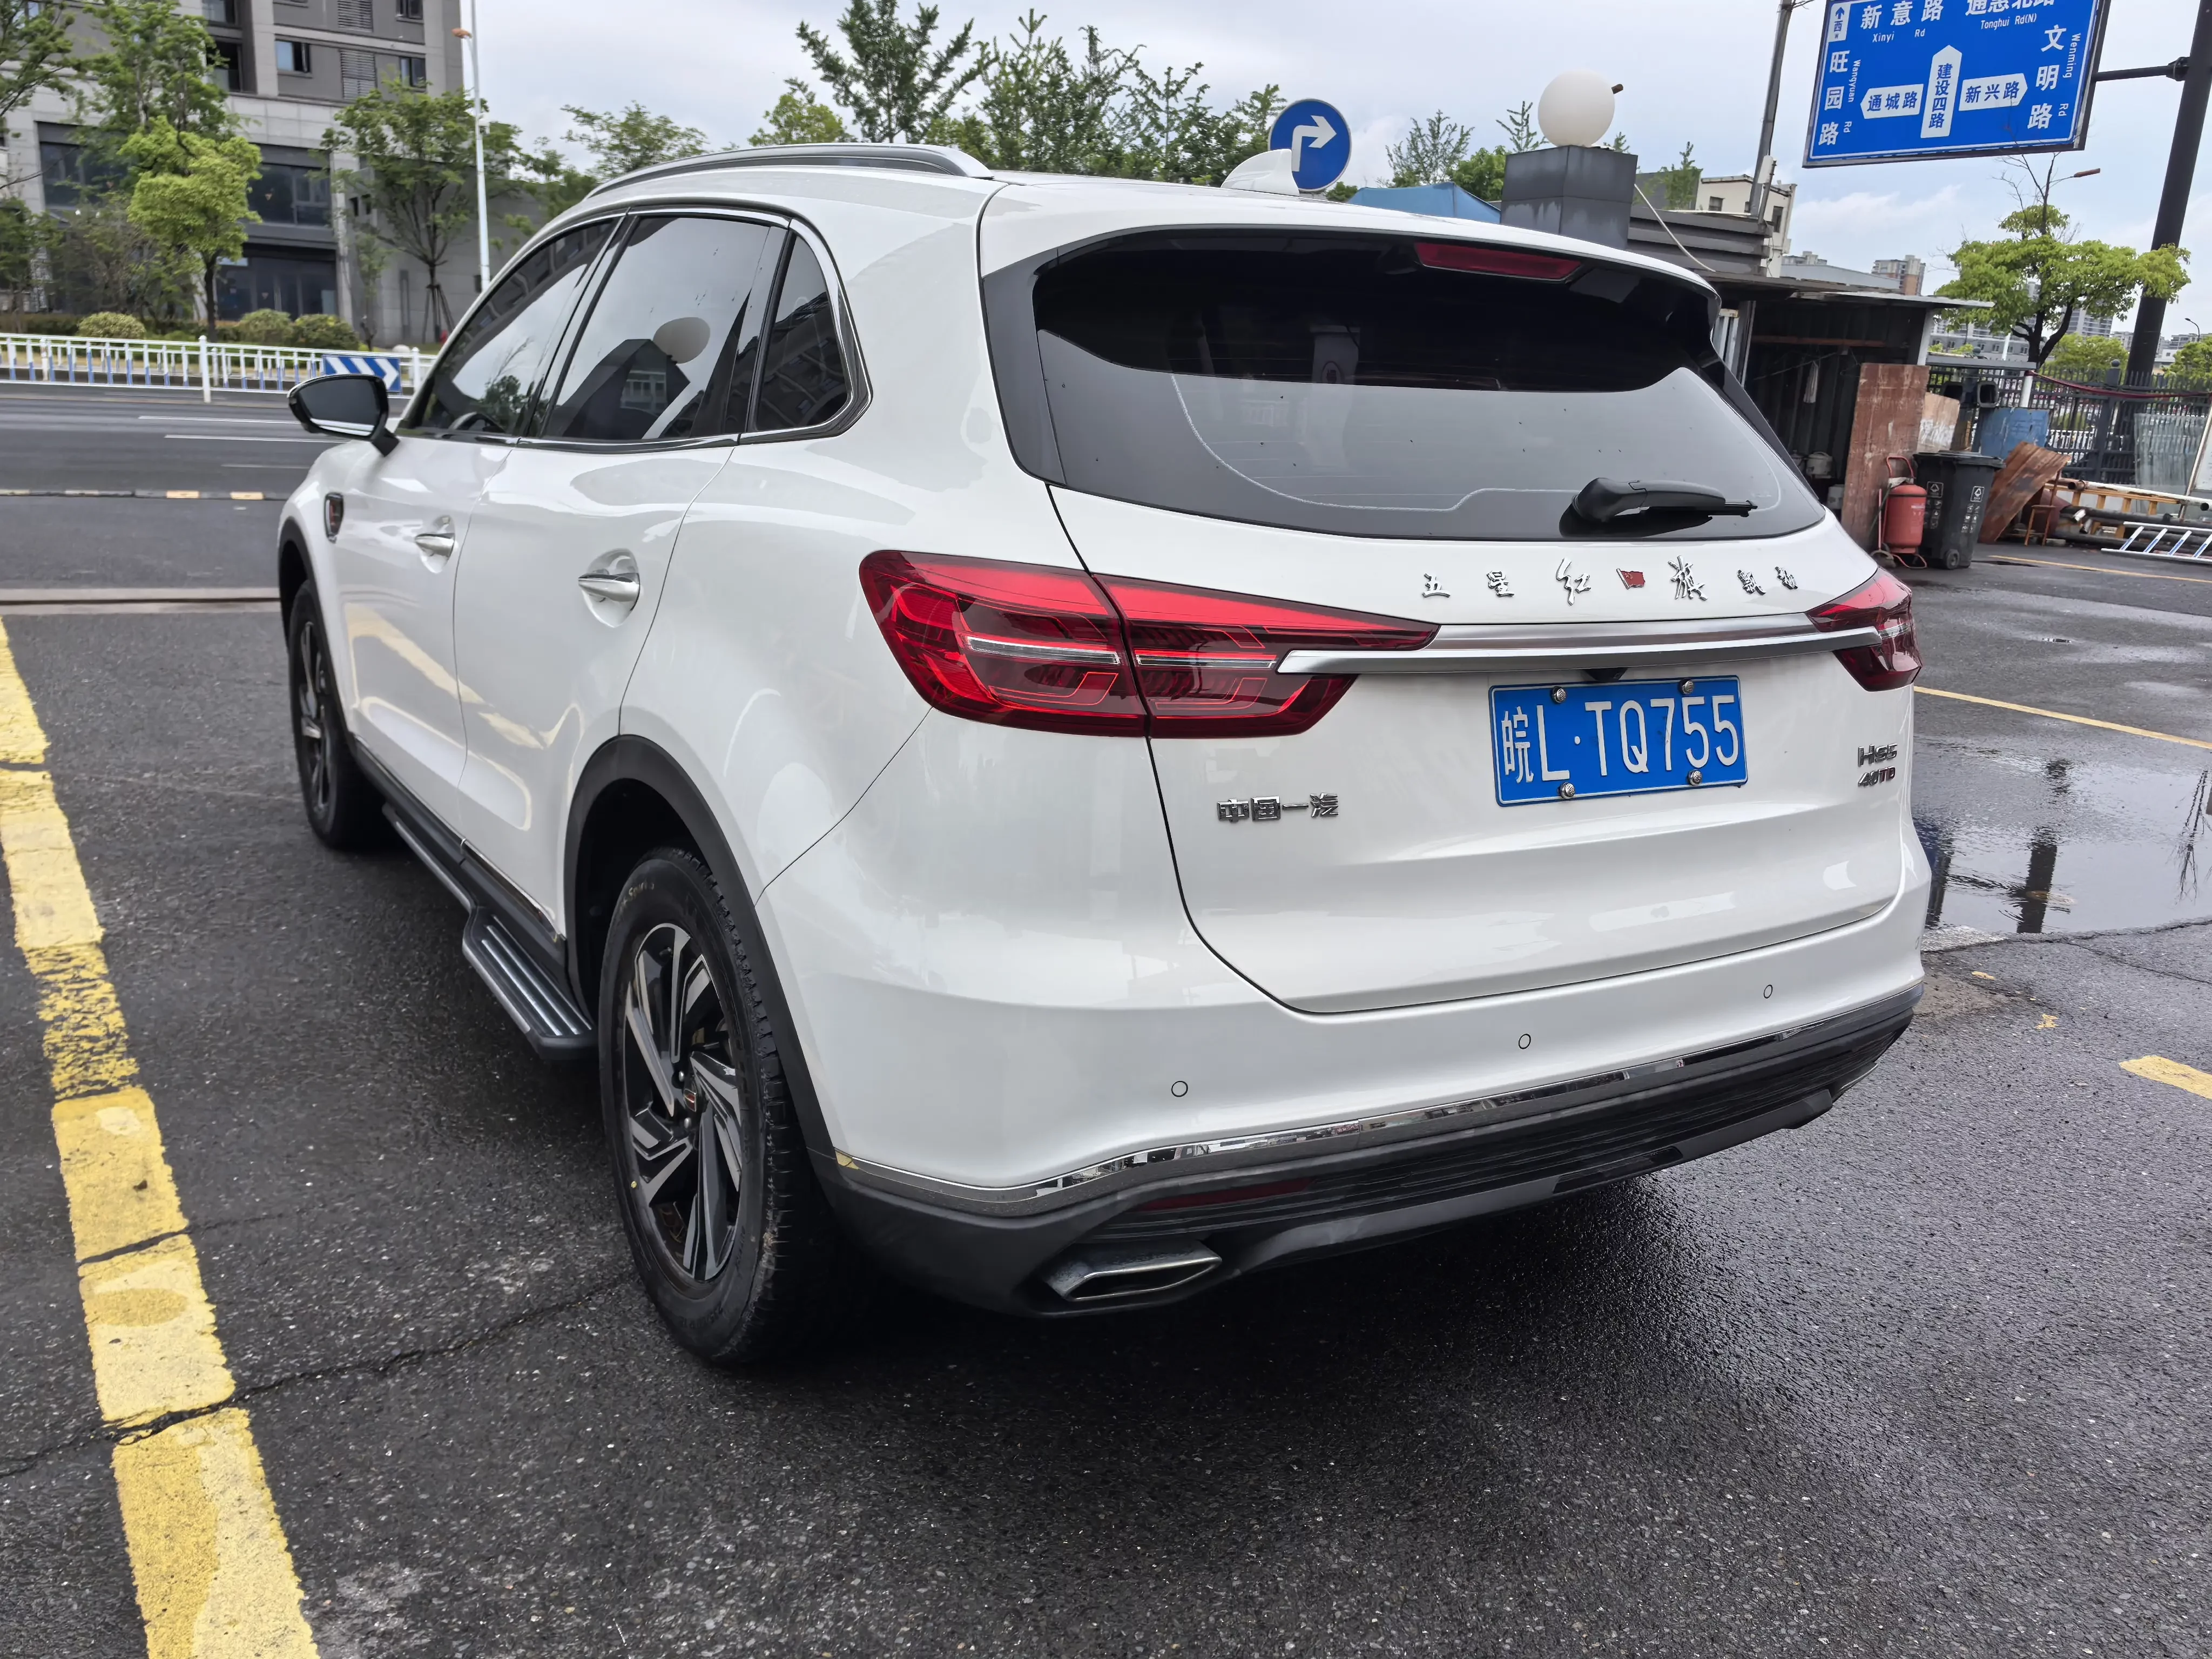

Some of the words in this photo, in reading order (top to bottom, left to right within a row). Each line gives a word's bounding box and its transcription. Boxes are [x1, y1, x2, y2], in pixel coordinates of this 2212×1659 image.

[1833, 20, 1844, 32] 西
[1860, 0, 1944, 29] 新意路
[1980, 16, 2010, 30] Tonghui
[2014, 12, 2037, 26] Rd(N)
[1872, 31, 1895, 43] Xinyi
[1914, 28, 1926, 38] Rd
[2062, 33, 2082, 79] Wenming
[1847, 59, 1862, 103] Wangyuan
[2027, 24, 2067, 130] 文明路
[1818, 50, 1851, 146] 旺园路
[1866, 90, 1918, 112] 通城路
[1928, 62, 1953, 129] 建设四路
[1964, 80, 2020, 104] 新兴路
[2058, 103, 2069, 117] Rd
[1843, 120, 1852, 133] Rd
[1858, 743, 1898, 767] HS5
[1217, 792, 1339, 824] 中国一汽
